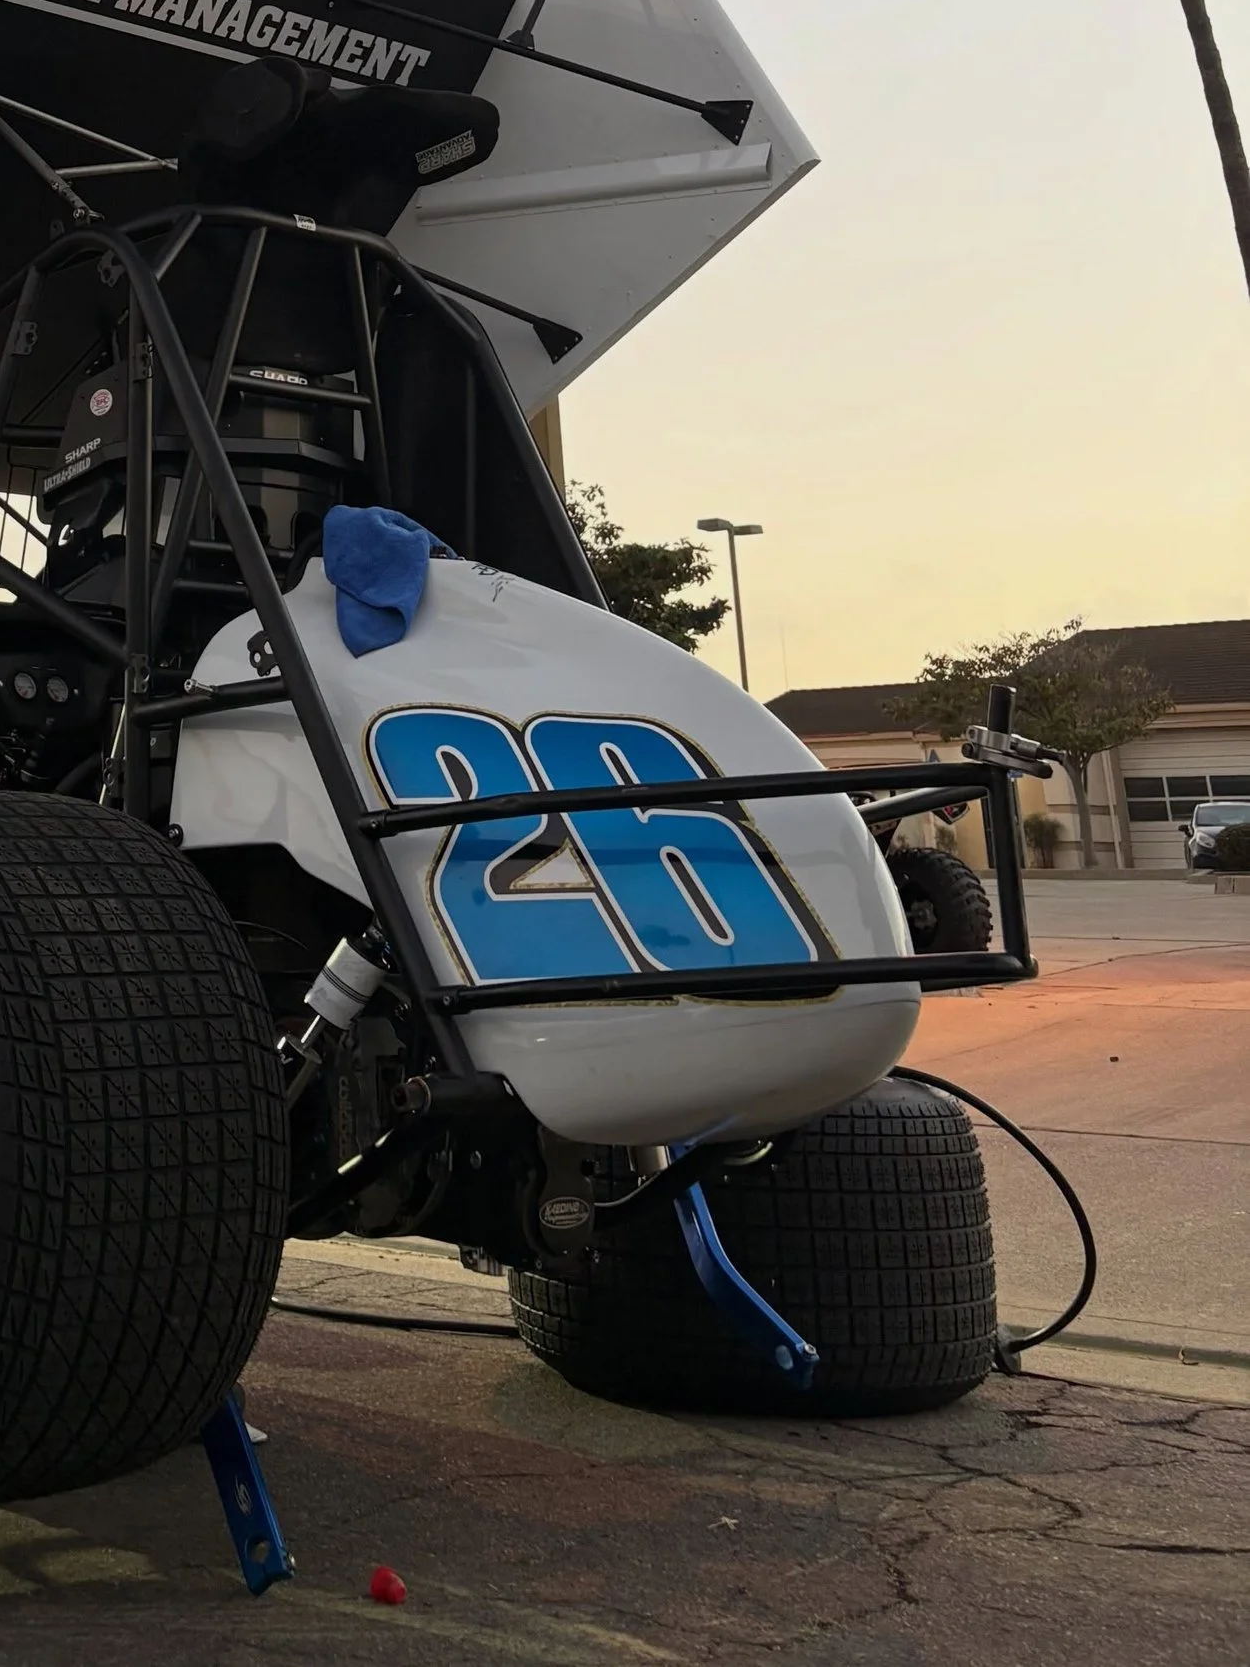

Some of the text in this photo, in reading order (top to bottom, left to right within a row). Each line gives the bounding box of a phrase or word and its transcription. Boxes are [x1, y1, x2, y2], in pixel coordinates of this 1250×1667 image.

[418, 137, 476, 174] SHARP
[65, 437, 102, 465] SHARP
[364, 702, 845, 1006] 26
